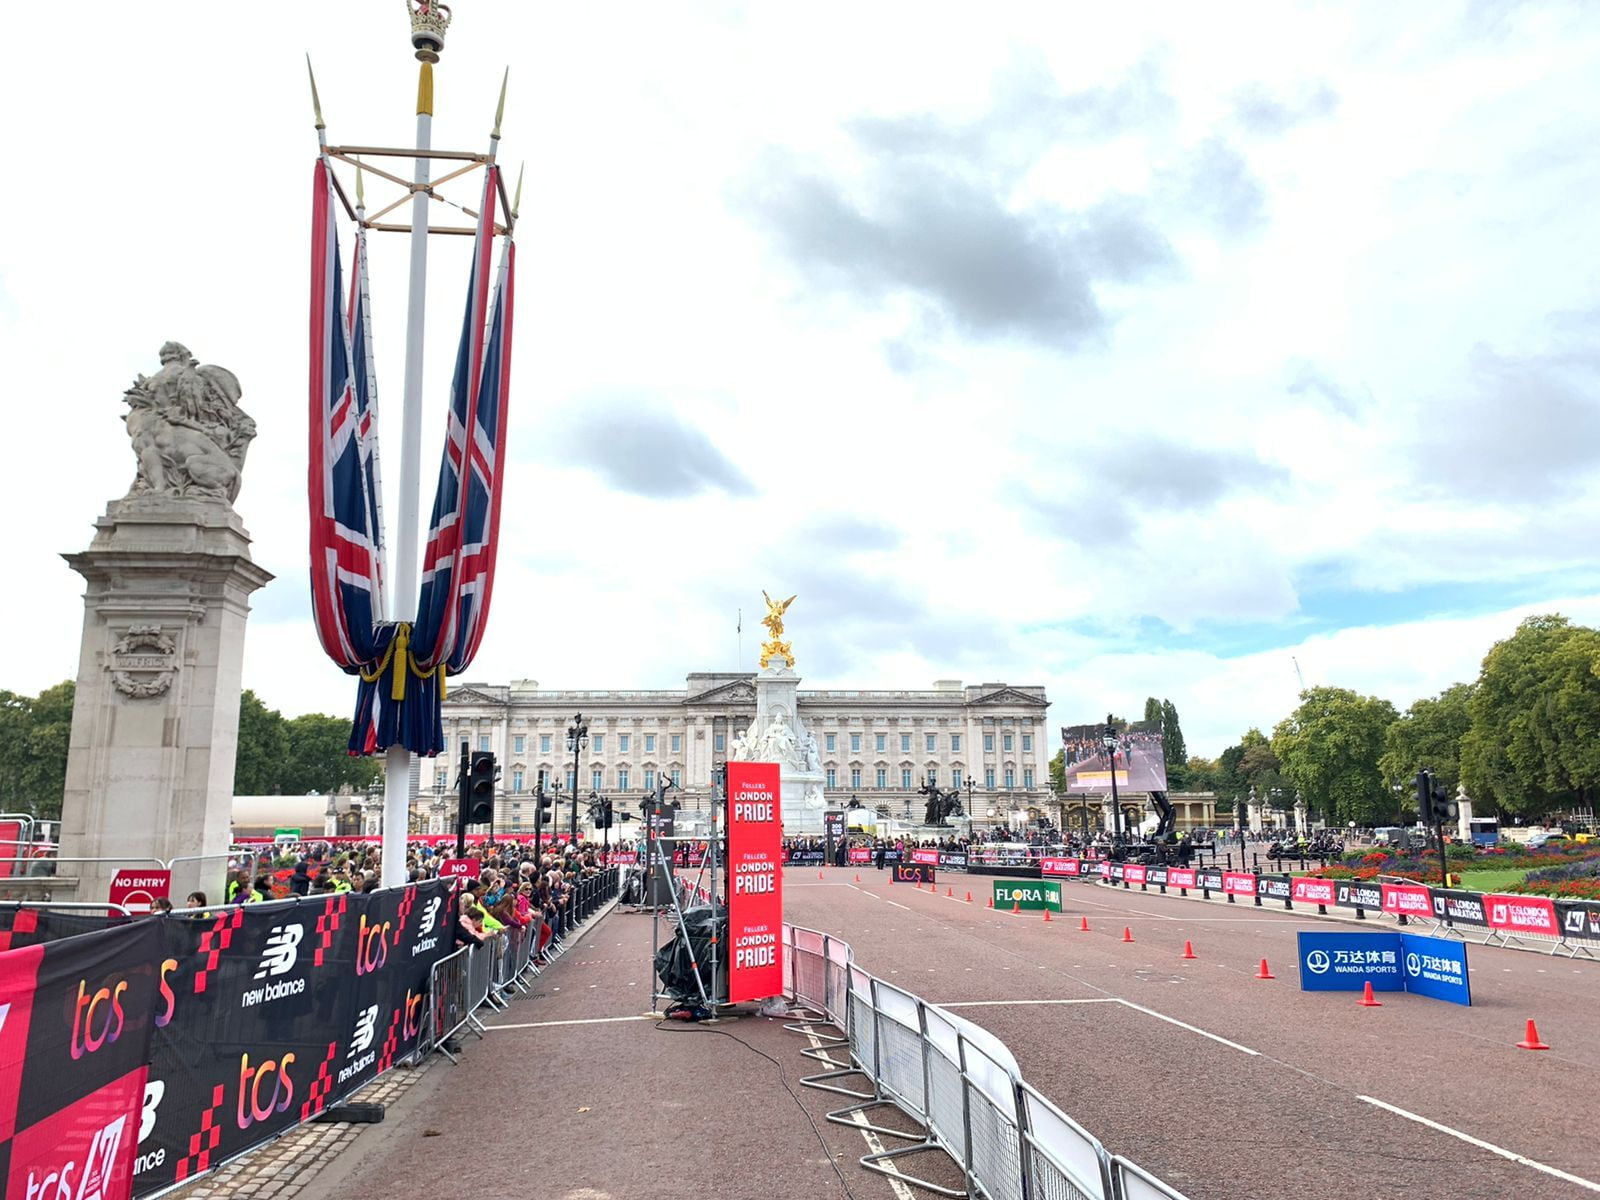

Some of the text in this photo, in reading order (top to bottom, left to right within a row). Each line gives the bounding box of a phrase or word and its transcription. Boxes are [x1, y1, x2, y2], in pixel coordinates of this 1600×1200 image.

[734, 791, 773, 801] LONDON
[735, 803, 773, 822] PRIDE
[451, 864, 468, 873] NO
[735, 862, 775, 873] LONDON
[898, 865, 922, 880] tcs
[115, 878, 166, 887] NO ENTRY
[735, 874, 775, 894] PRIDE
[996, 888, 1042, 901] FLORA
[1455, 899, 1481, 912] LONDON
[1520, 905, 1549, 917] LONDON
[1448, 907, 1484, 920] MARATHON
[1511, 915, 1551, 928] MARATHON
[356, 914, 391, 976] tcs
[735, 934, 775, 947] LONDON
[736, 946, 776, 969] PRIDE
[1333, 950, 1396, 964] 万达体育
[1335, 966, 1397, 974] WANDA SPORTS
[1422, 955, 1462, 975] 万达体育
[1423, 971, 1463, 986] WANDA SPORTS
[242, 978, 305, 1008] new balance
[71, 979, 128, 1060] tcs
[237, 1052, 296, 1130] tcs
